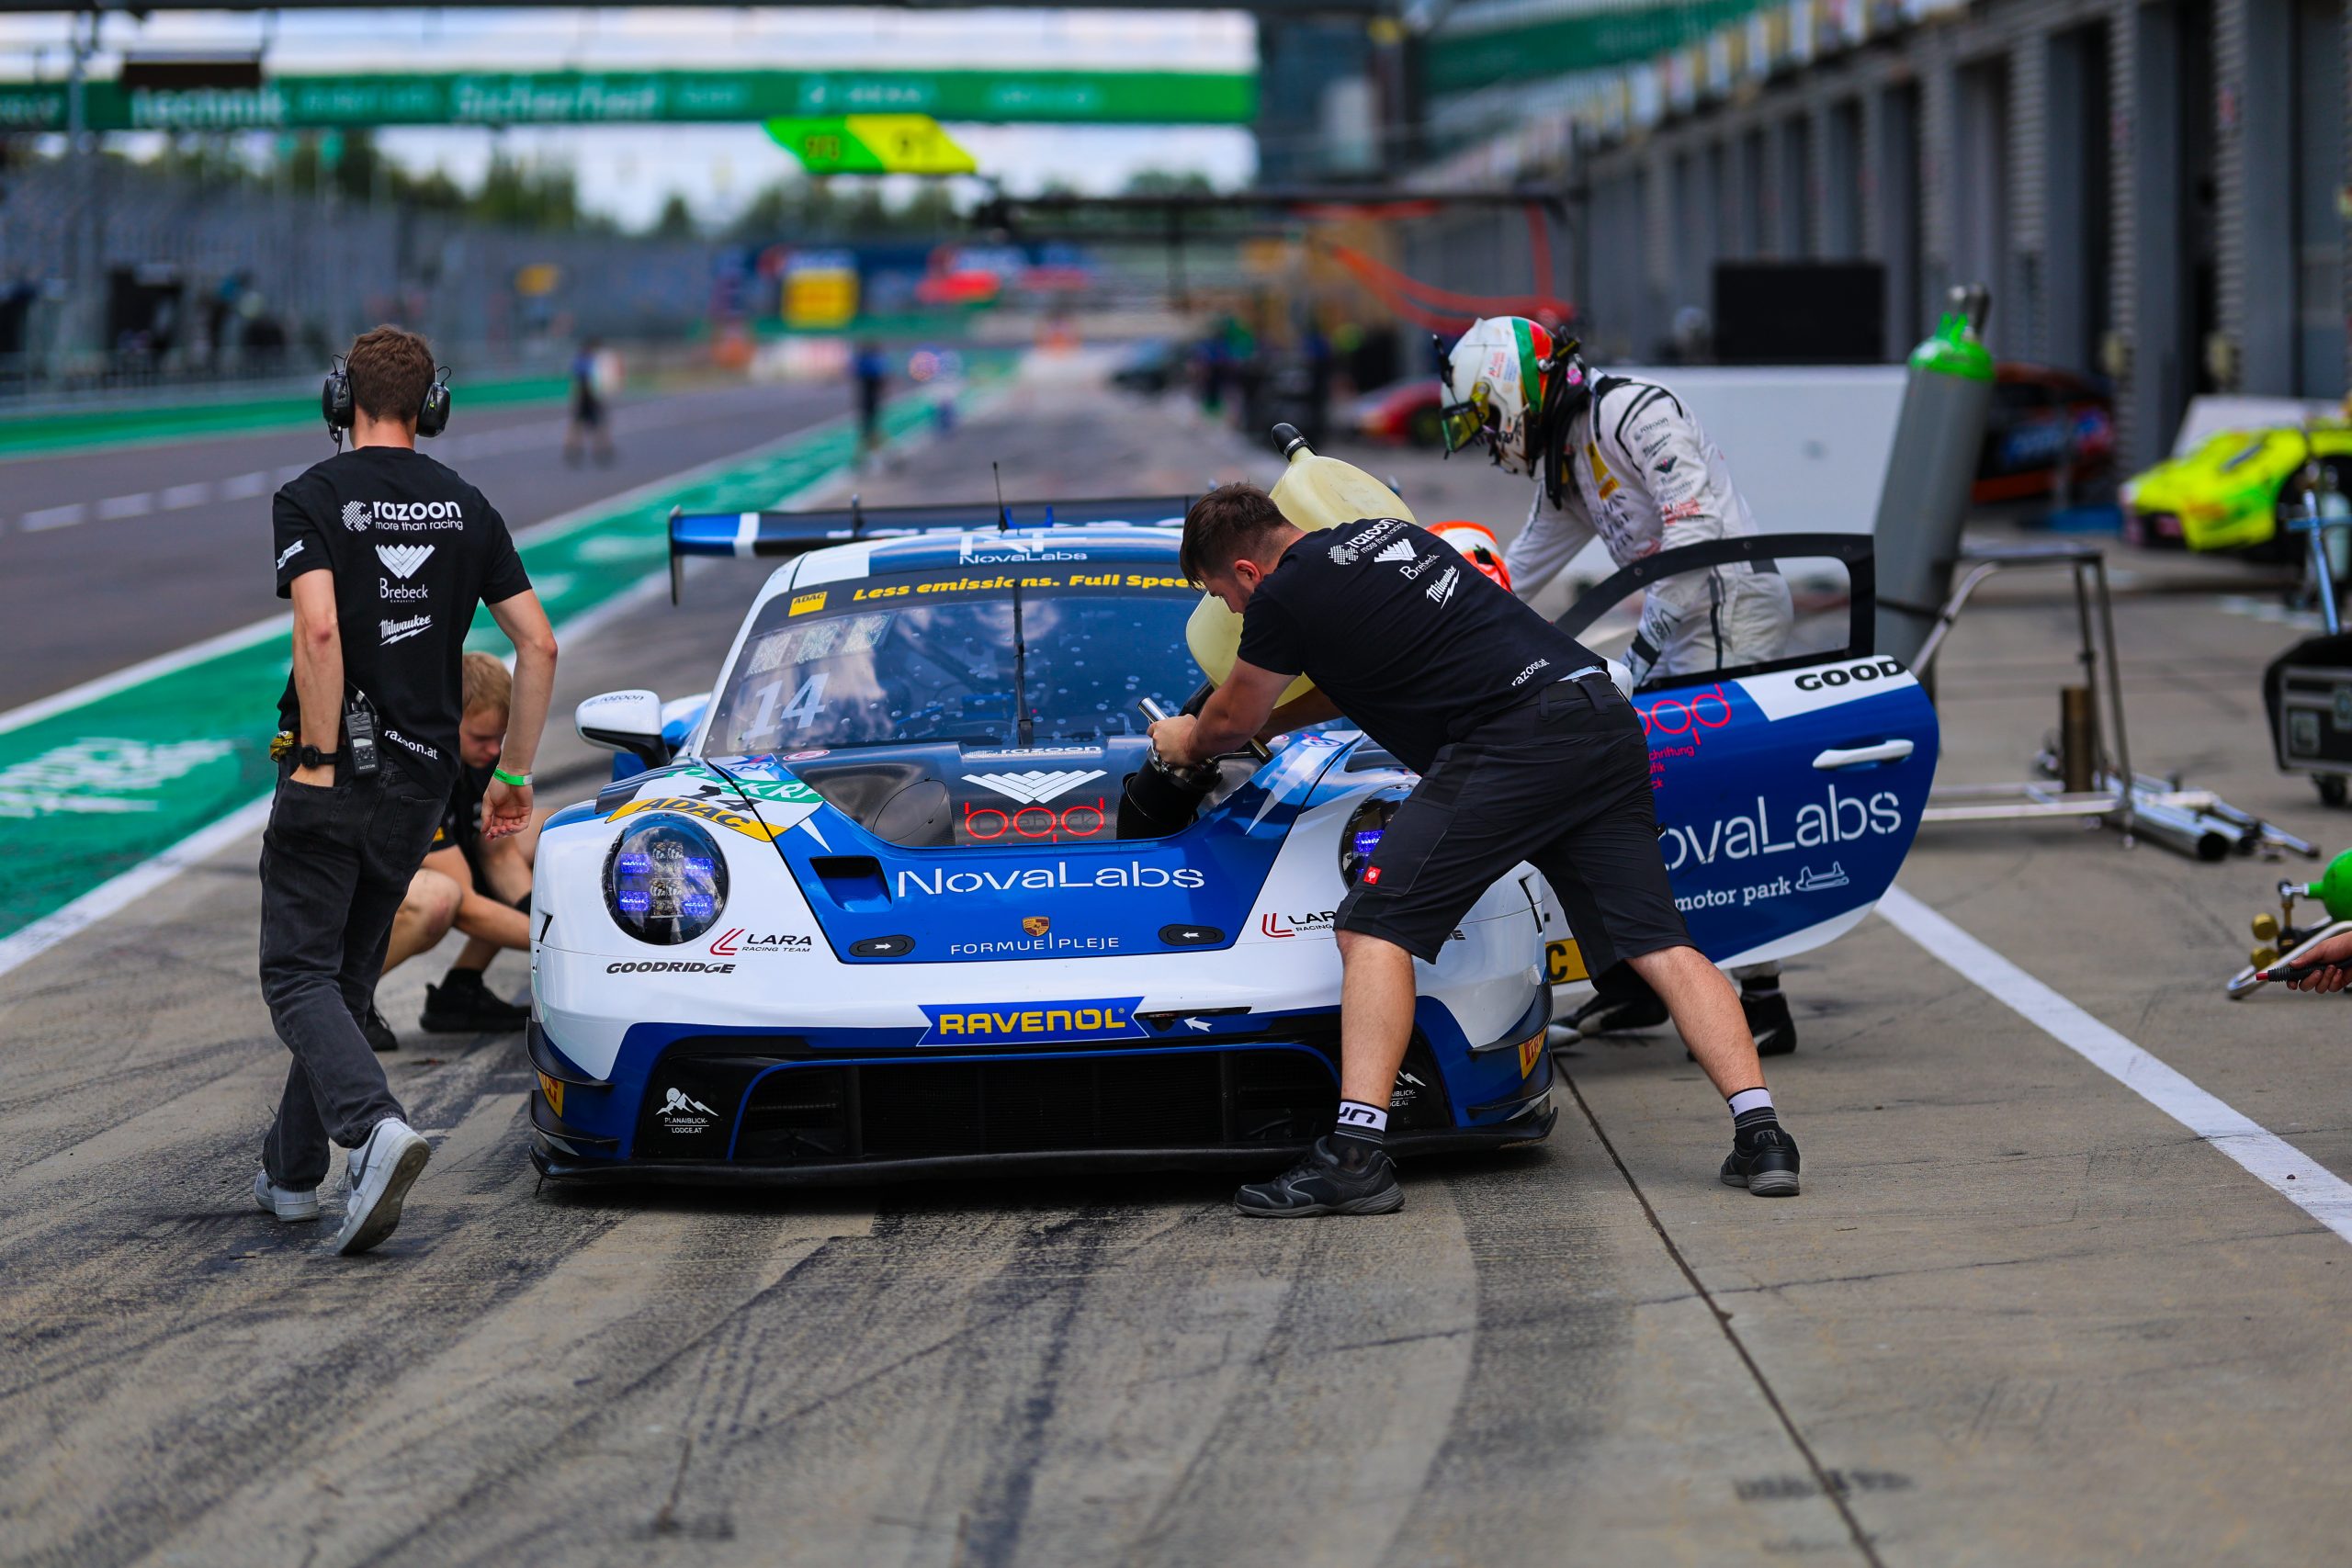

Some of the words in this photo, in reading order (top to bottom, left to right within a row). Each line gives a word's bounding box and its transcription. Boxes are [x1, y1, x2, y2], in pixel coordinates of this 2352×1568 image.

[373, 501, 461, 521] razoon
[375, 522, 399, 530] more
[401, 521, 427, 530] than
[429, 519, 463, 531] racing
[1345, 519, 1398, 547] razoon
[1361, 542, 1378, 553] more
[959, 551, 1088, 565] NovaLabs
[379, 578, 429, 598] Brebeck
[853, 586, 910, 601] Less
[1069, 574, 1121, 586] Full
[1126, 575, 1205, 589] Spee
[1426, 565, 1457, 603] Milwaukee
[793, 592, 825, 605] ADAC
[379, 615, 431, 638] Milwaukee
[743, 673, 829, 738] 14
[1001, 746, 1102, 754] razoon
[1649, 746, 1695, 761] chriftung
[638, 797, 752, 828] ADAC
[1657, 784, 1901, 871] ovaLabs
[898, 861, 1204, 897] NovaLabs
[1674, 888, 1736, 911] motor
[1743, 876, 1792, 906] park
[1287, 911, 1337, 924] LAR
[747, 934, 812, 945] LARA
[606, 962, 736, 974] GOODRIDGE
[940, 1009, 1126, 1034] RAVENOL
